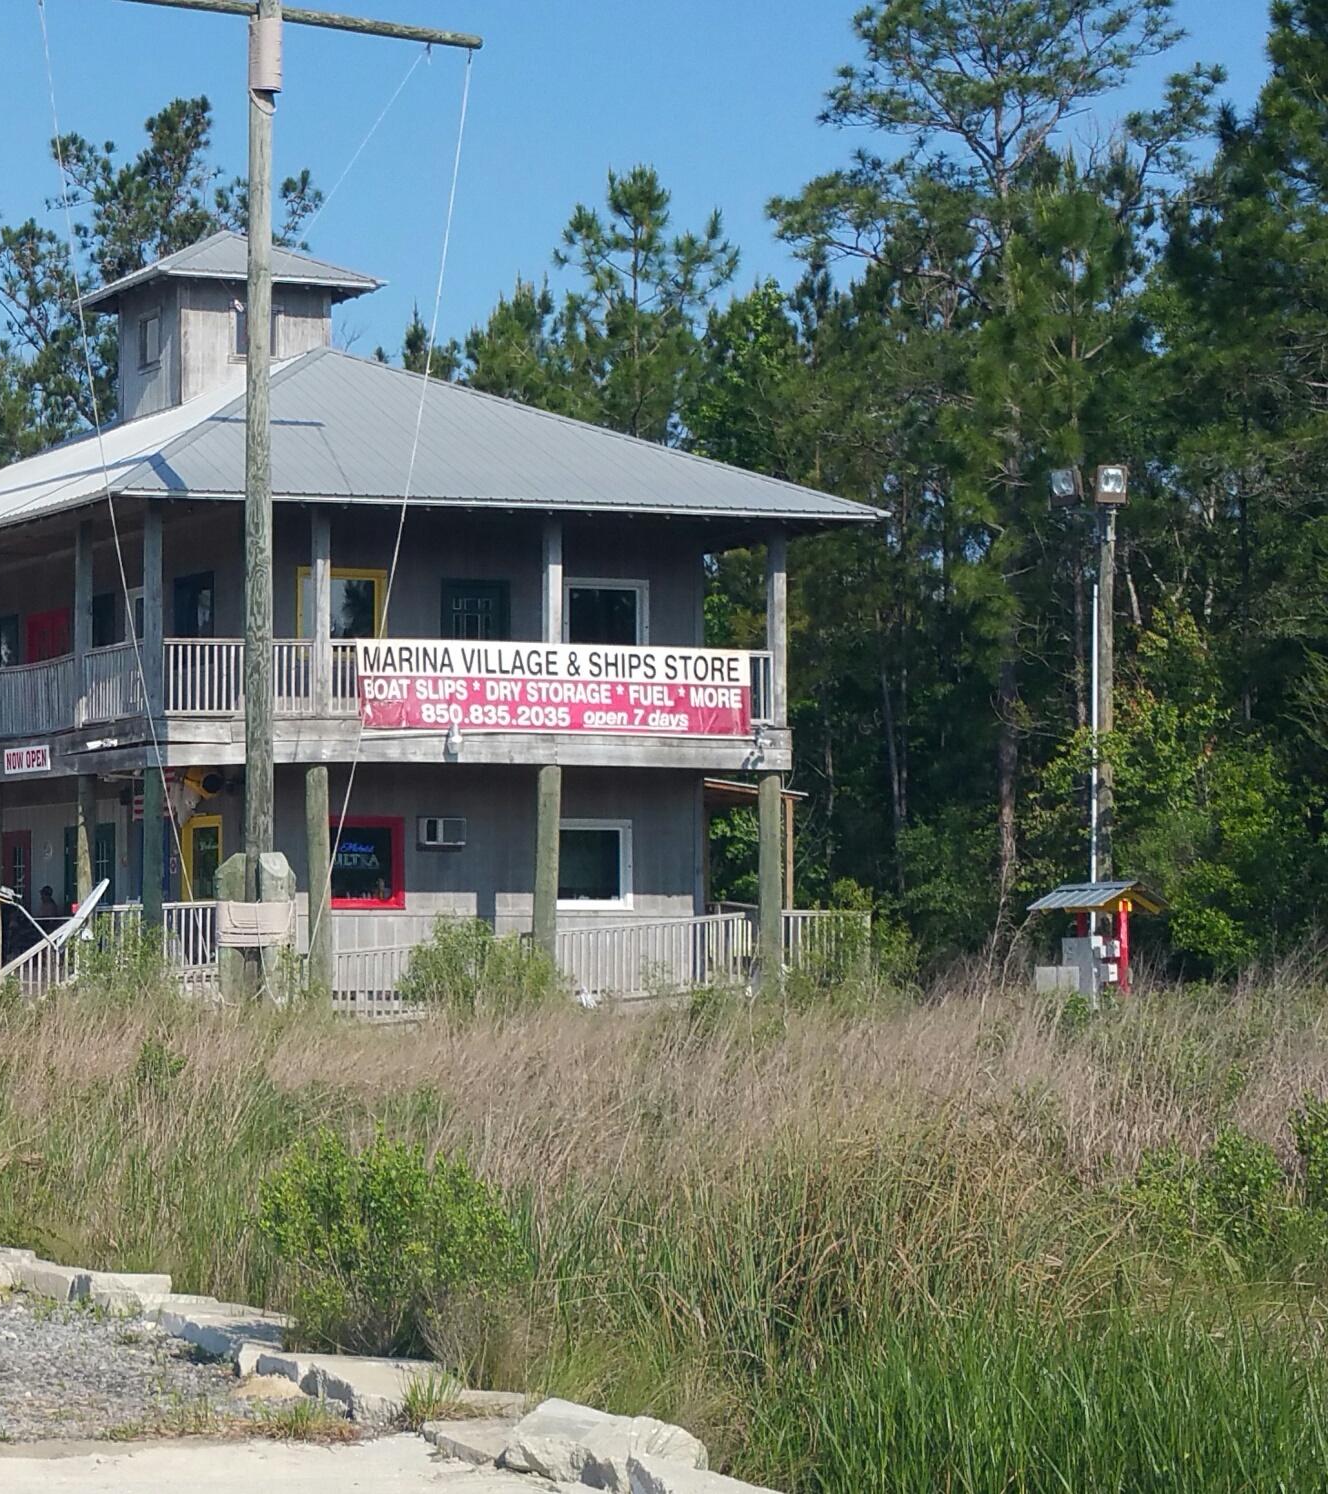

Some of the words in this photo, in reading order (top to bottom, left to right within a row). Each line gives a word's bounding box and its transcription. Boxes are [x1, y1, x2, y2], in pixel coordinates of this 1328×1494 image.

[363, 645, 455, 674] MARINA
[461, 647, 559, 677] VILLAGE
[566, 650, 581, 678] &
[588, 651, 657, 680] SHIPS
[664, 654, 741, 683] STORE
[363, 677, 411, 700] BOAT
[415, 679, 469, 701] SLIPS
[485, 680, 522, 702] DRY
[526, 681, 613, 705] STORAGE
[628, 684, 675, 706] FUEL
[689, 686, 743, 709] MORE
[420, 702, 571, 727] 850.835.2035
[583, 710, 628, 728] open
[633, 708, 645, 726] 7
[647, 709, 690, 729] days
[6, 751, 24, 770] NOW
[26, 748, 47, 768] OPEN
